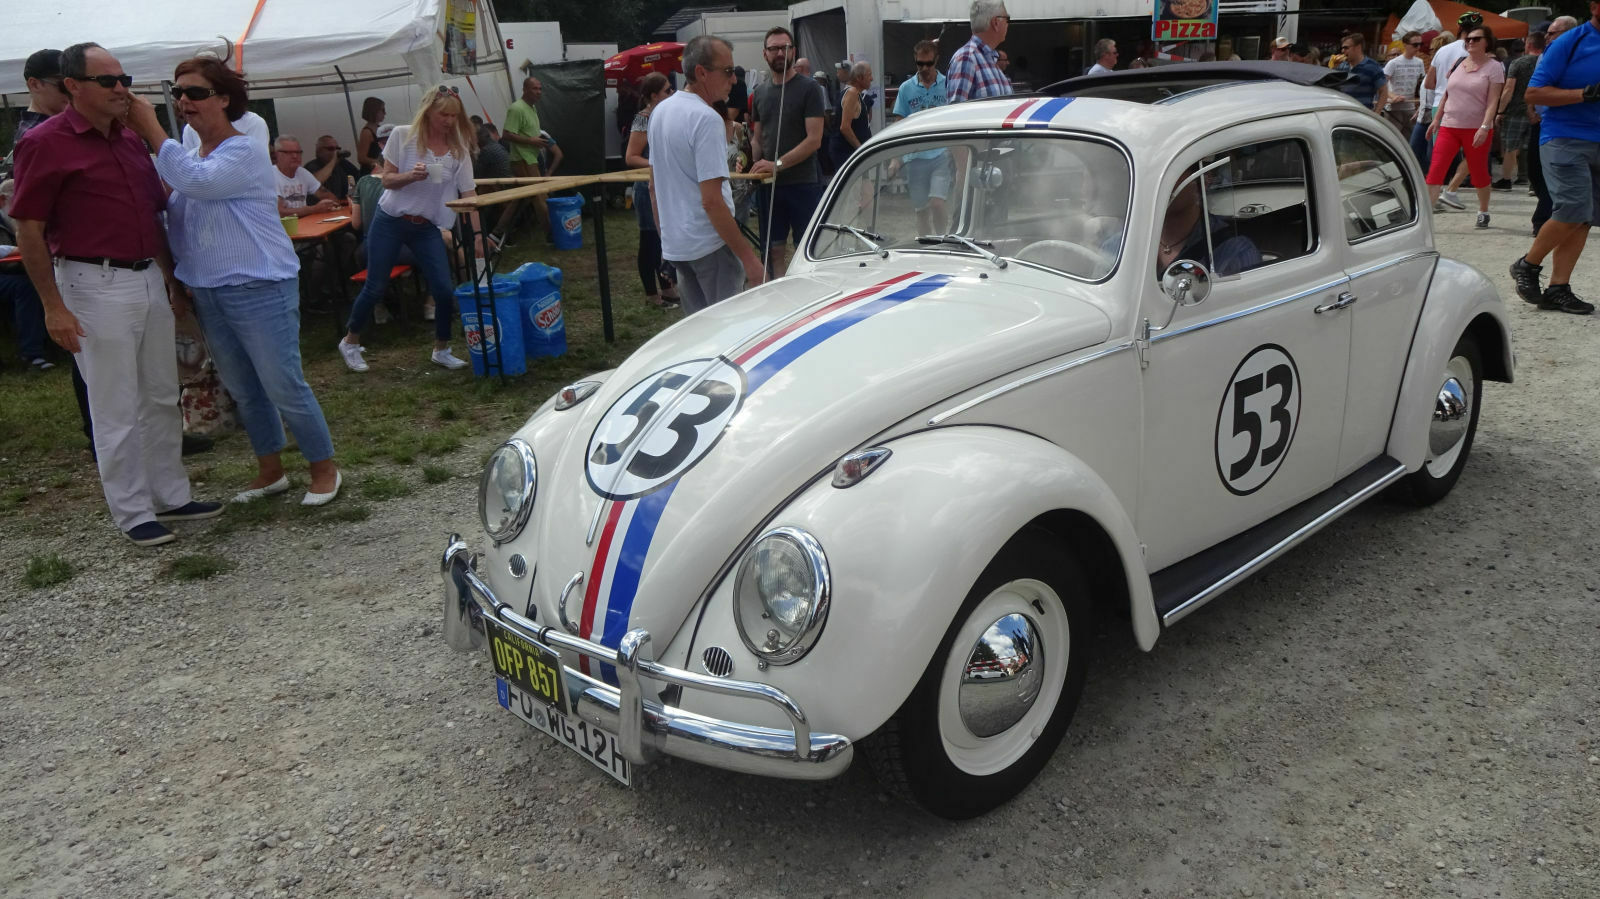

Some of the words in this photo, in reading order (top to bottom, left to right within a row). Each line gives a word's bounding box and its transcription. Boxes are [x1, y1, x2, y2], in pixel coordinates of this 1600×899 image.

[1155, 20, 1216, 39] Pizza
[590, 371, 737, 480] 53
[1229, 363, 1293, 482] 53
[493, 636, 524, 681] OFP
[526, 655, 559, 703] 857
[503, 630, 540, 657] CALIFORNIA
